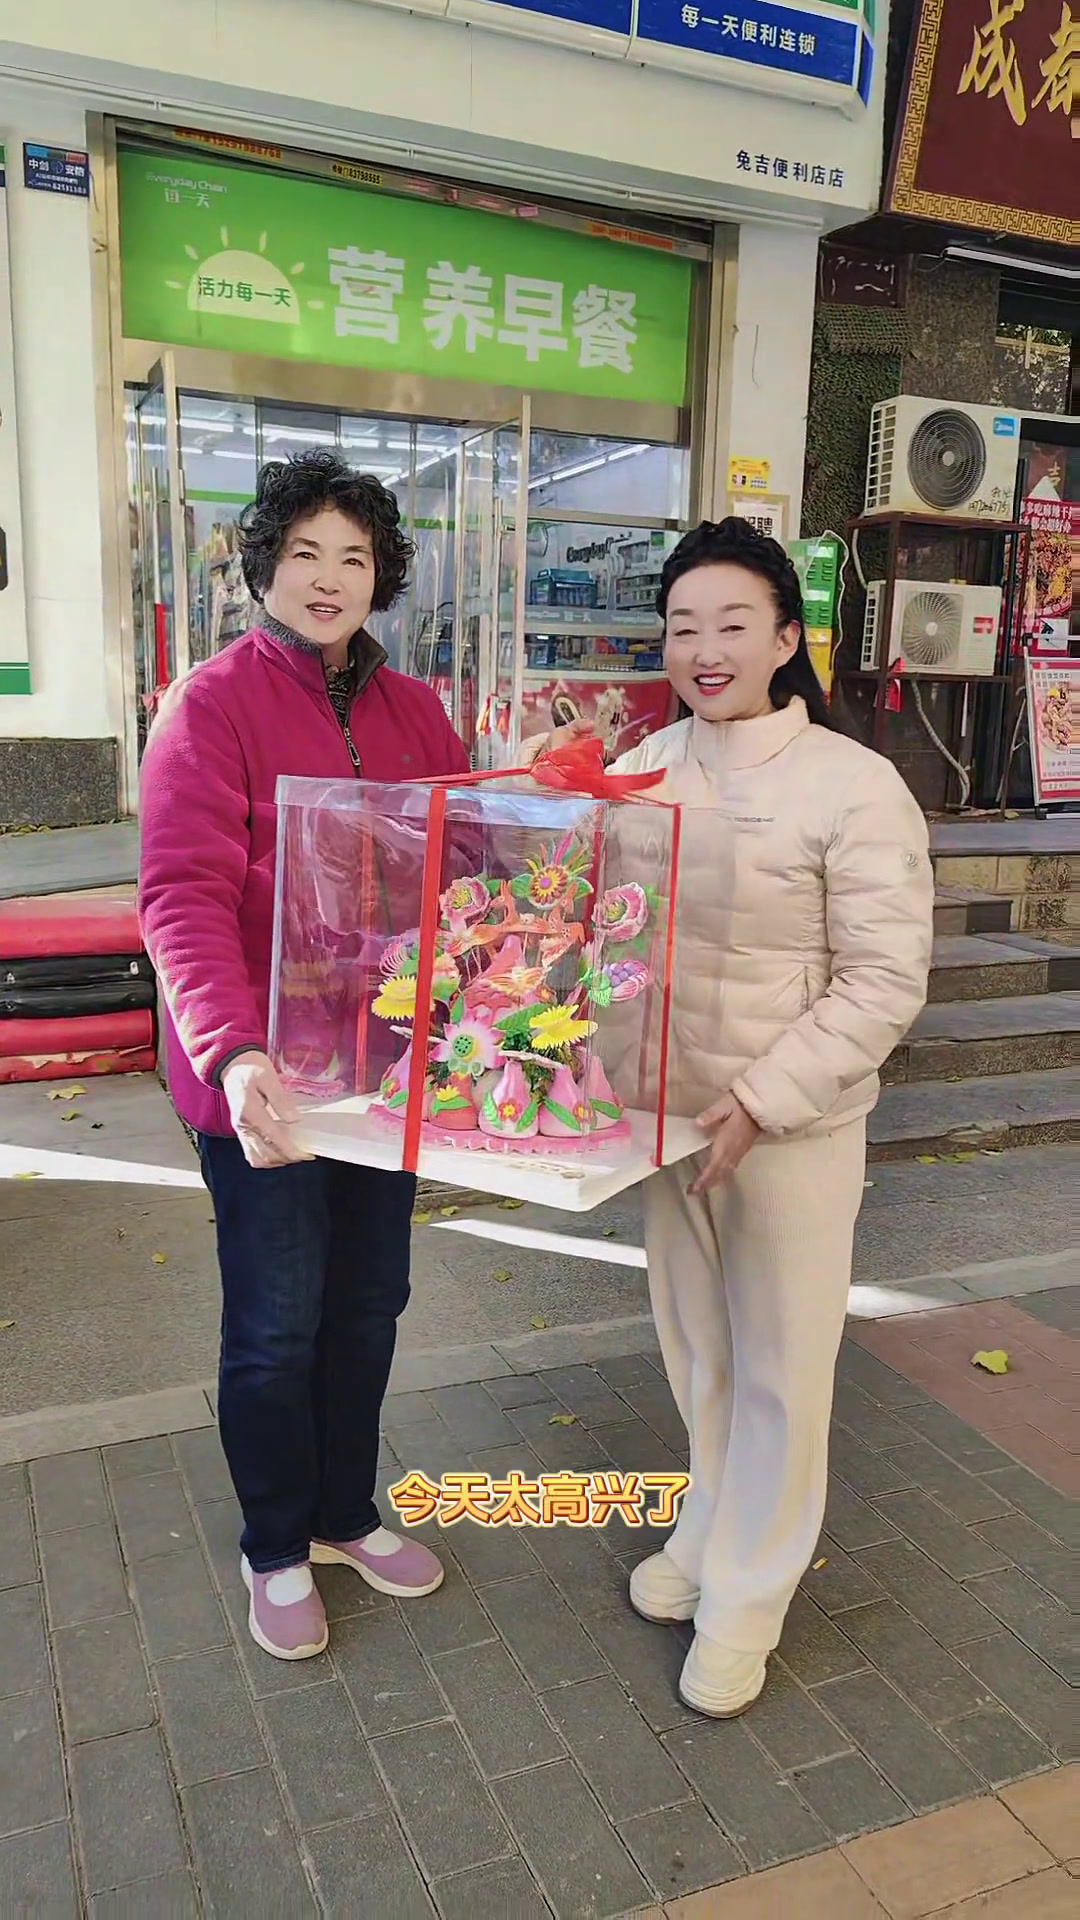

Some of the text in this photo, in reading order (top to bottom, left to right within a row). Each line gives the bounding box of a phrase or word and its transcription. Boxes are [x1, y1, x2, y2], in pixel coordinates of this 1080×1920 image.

[681, 4, 816, 57] 每一天便利连锁
[198, 276, 291, 307] 活力每一天
[328, 246, 637, 374] 营养早餐
